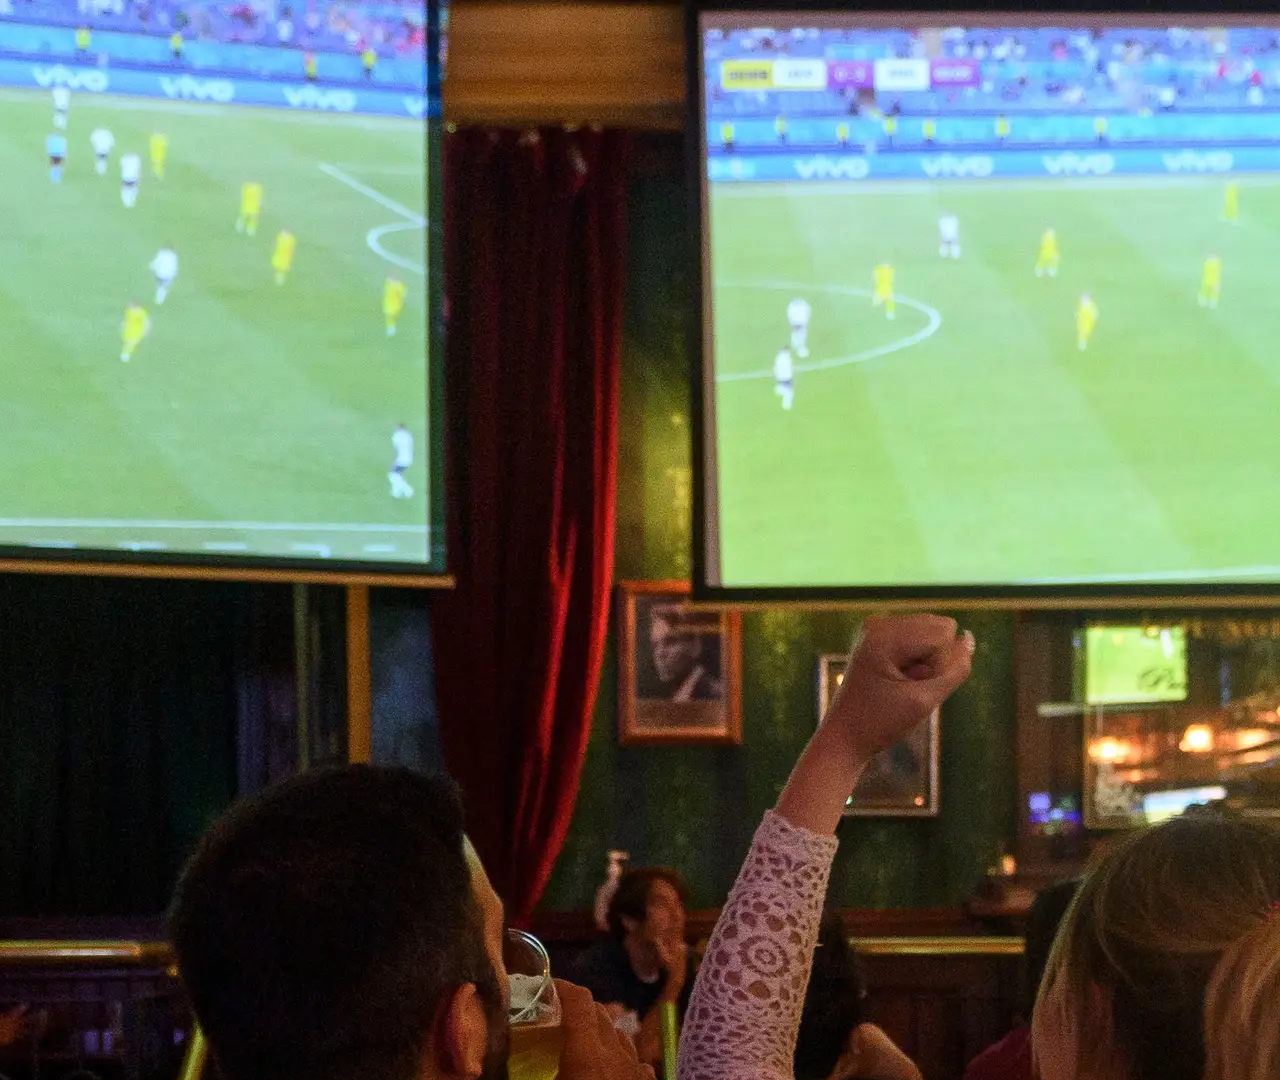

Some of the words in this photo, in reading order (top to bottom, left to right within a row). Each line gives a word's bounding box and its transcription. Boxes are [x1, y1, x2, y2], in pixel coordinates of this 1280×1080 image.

[32, 65, 109, 92] vivo
[160, 76, 234, 101] vivo
[283, 86, 357, 112] vivo
[794, 157, 869, 179] vivo
[919, 155, 994, 177] vivo
[1041, 153, 1115, 175] vivo
[1162, 150, 1234, 173] vivo
